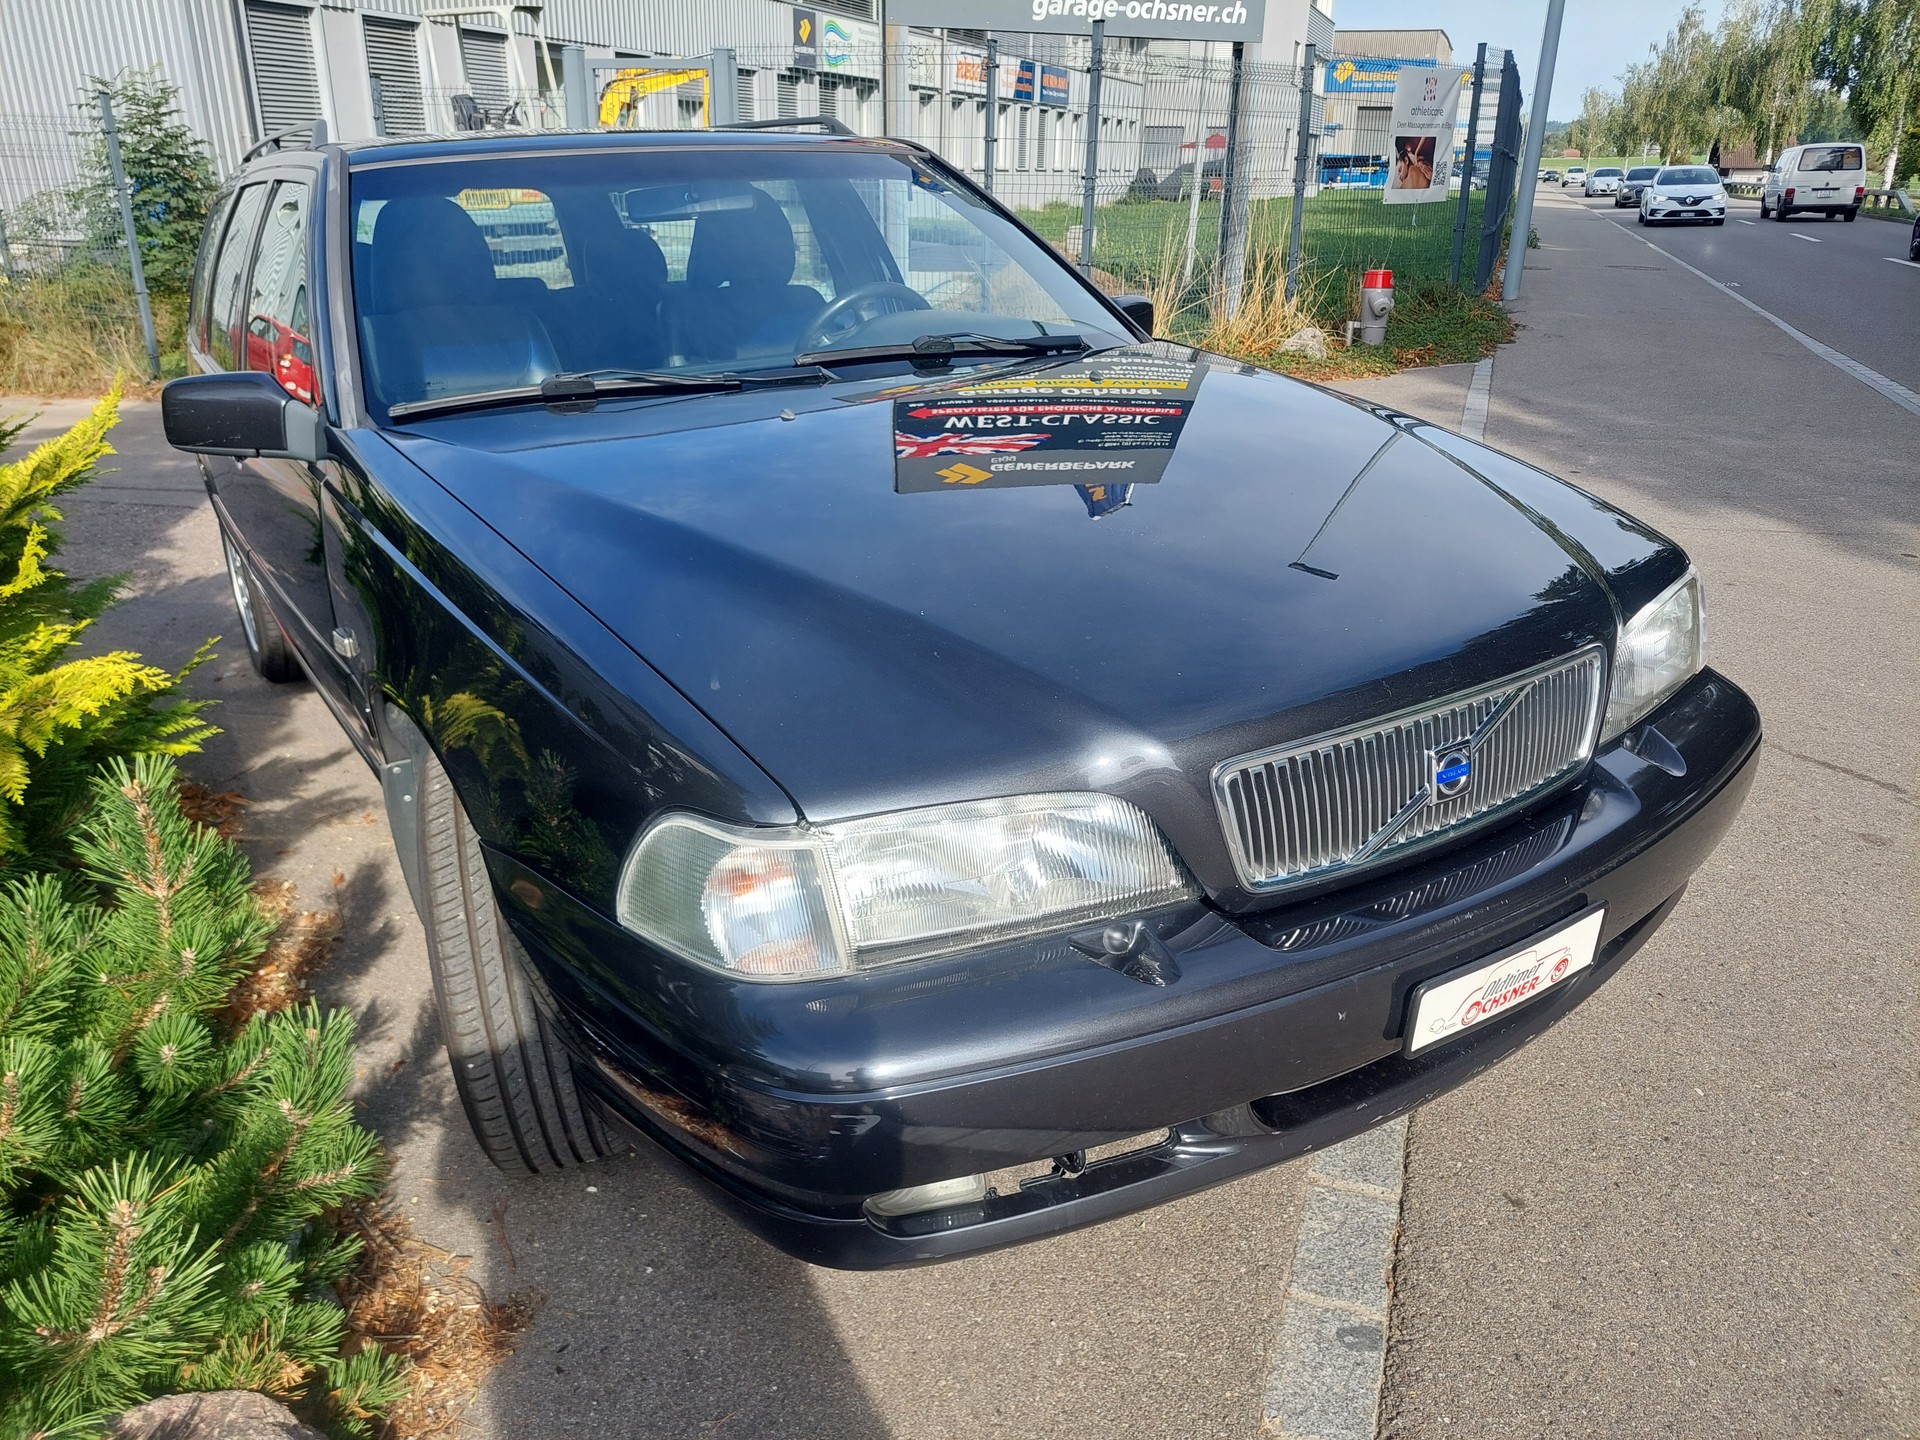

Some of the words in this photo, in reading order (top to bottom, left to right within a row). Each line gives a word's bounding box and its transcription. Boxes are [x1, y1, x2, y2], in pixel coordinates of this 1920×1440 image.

[1032, 0, 1248, 24] garage-ochsner.ch
[1410, 106, 1444, 117] athleticare
[1481, 961, 1545, 1000] Oldtimer
[1461, 976, 1540, 1026] OCHSNER
